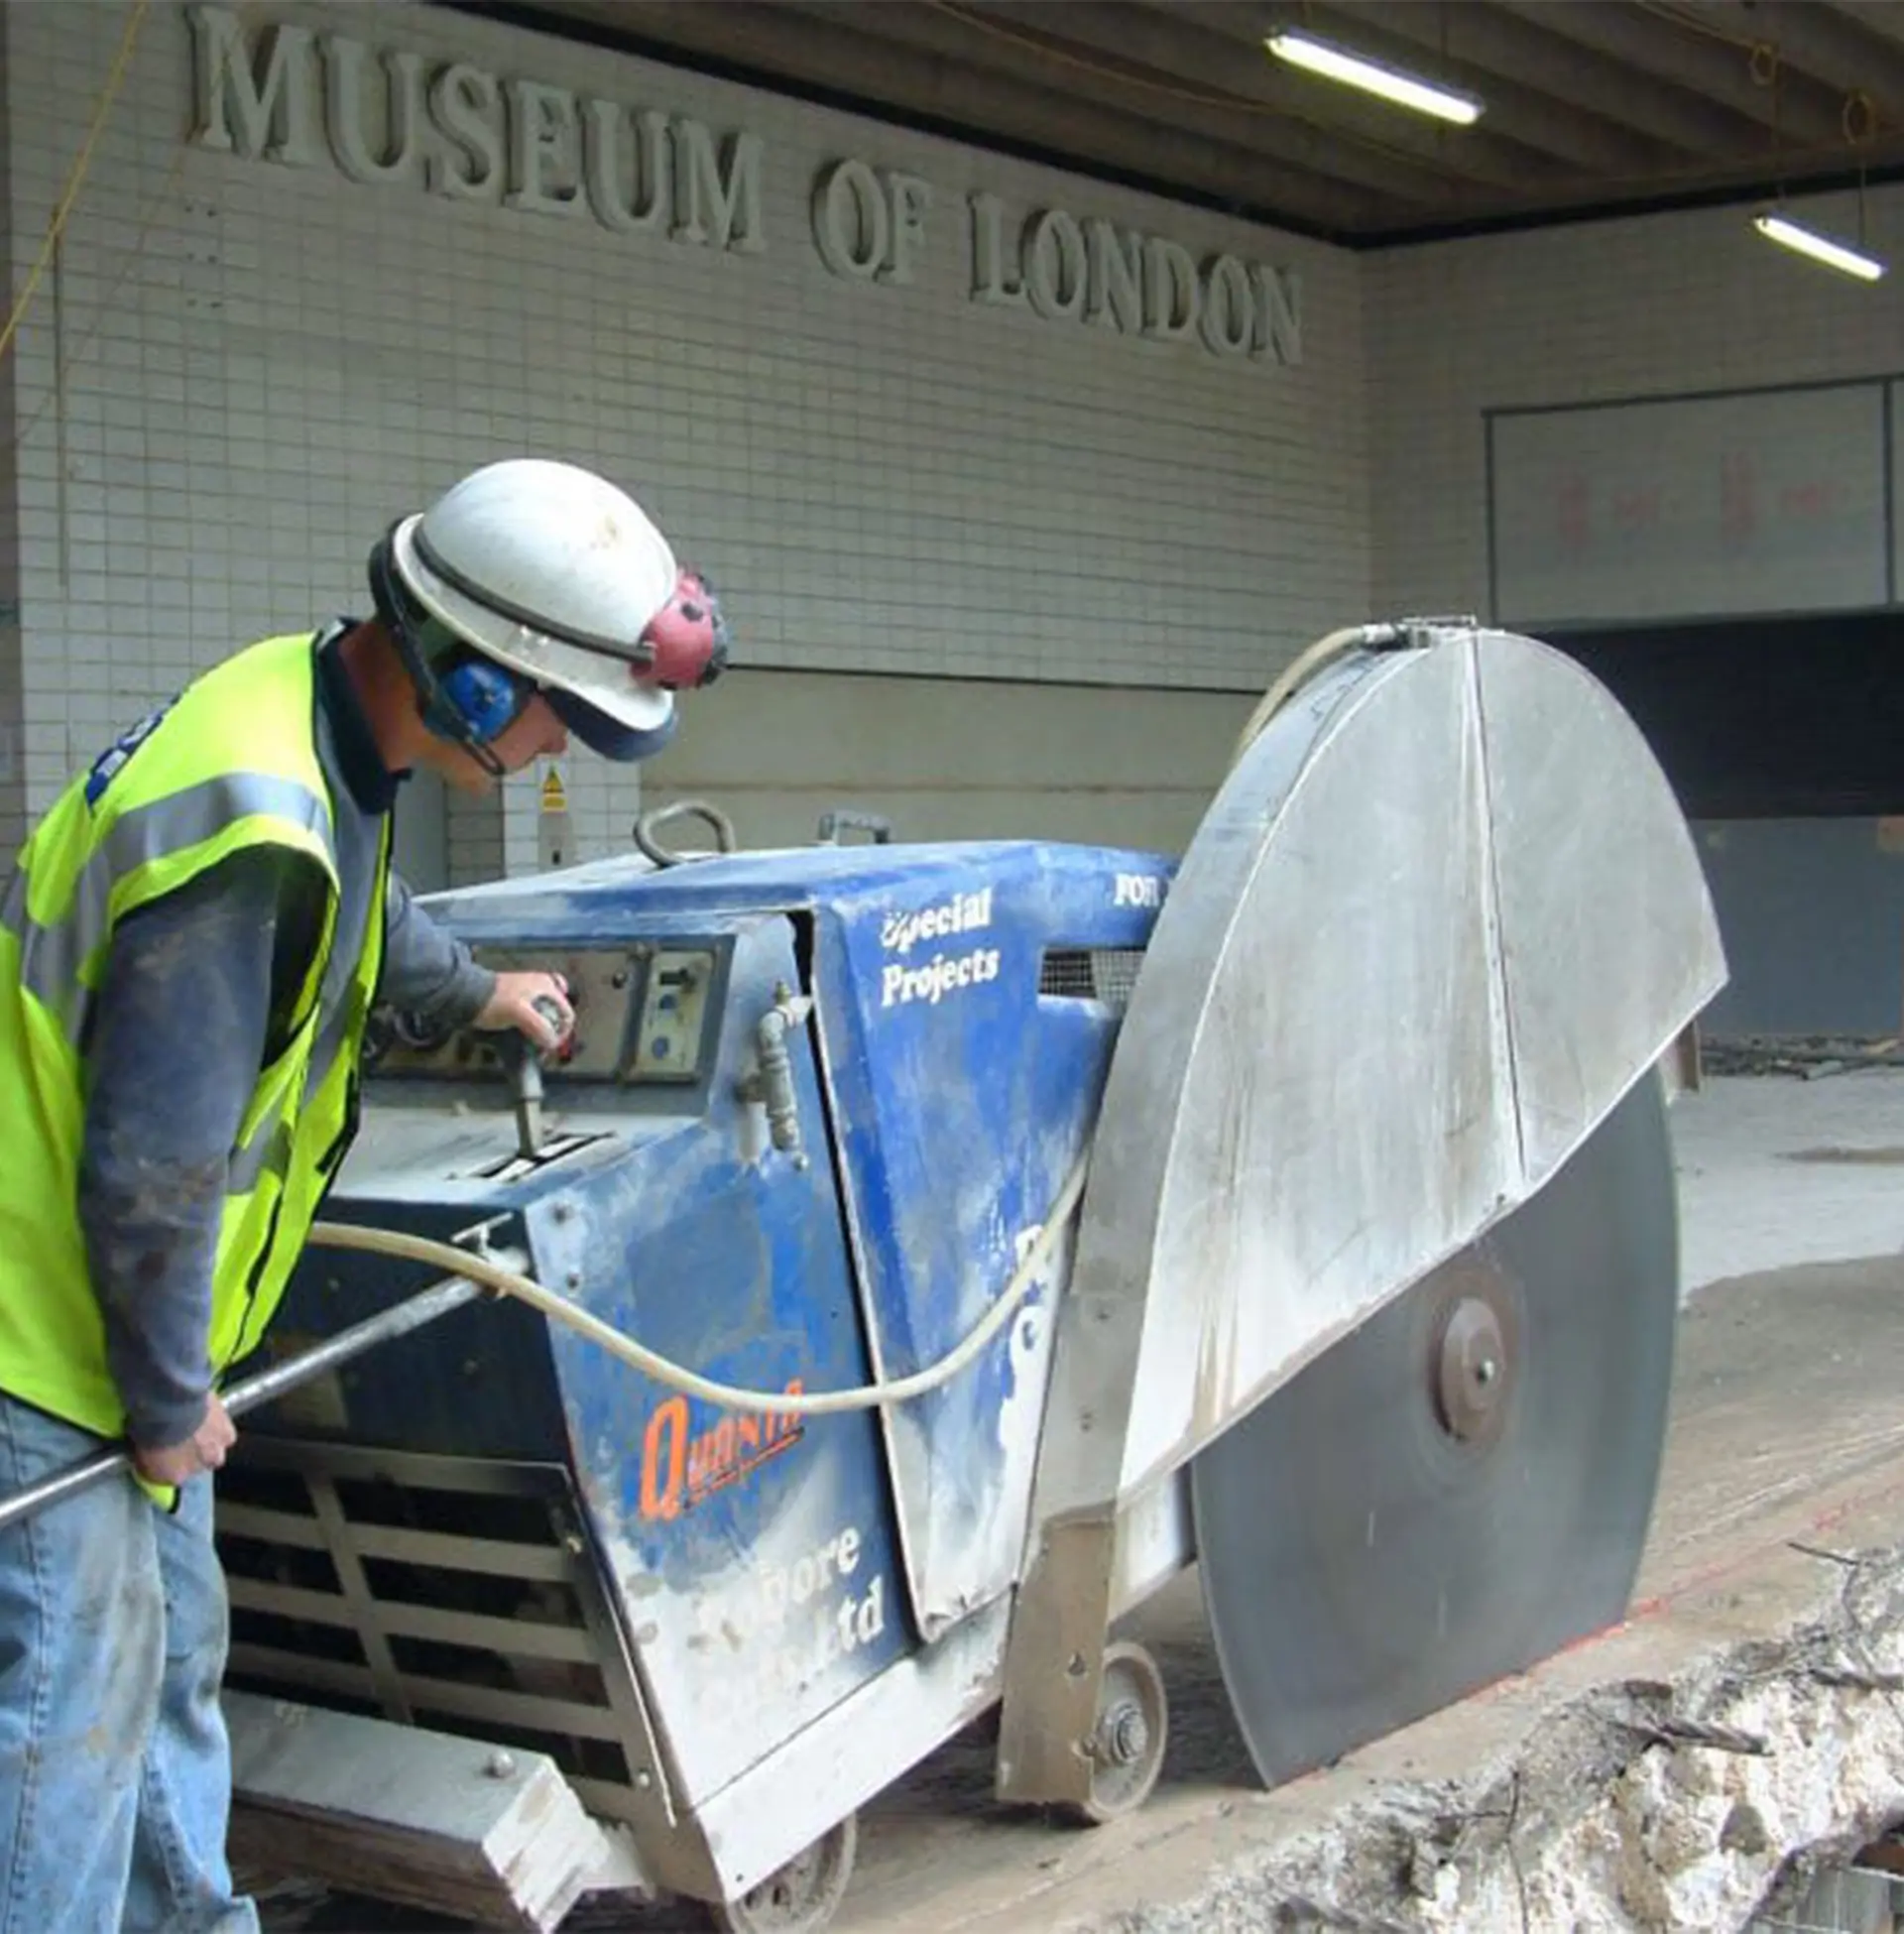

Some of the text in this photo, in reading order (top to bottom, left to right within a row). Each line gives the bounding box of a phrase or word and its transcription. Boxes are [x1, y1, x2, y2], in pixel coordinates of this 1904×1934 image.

[186, 6, 1303, 366] MUSEUM OF LONDON
[880, 886, 993, 954] Special
[881, 948, 1001, 1008] Projects
